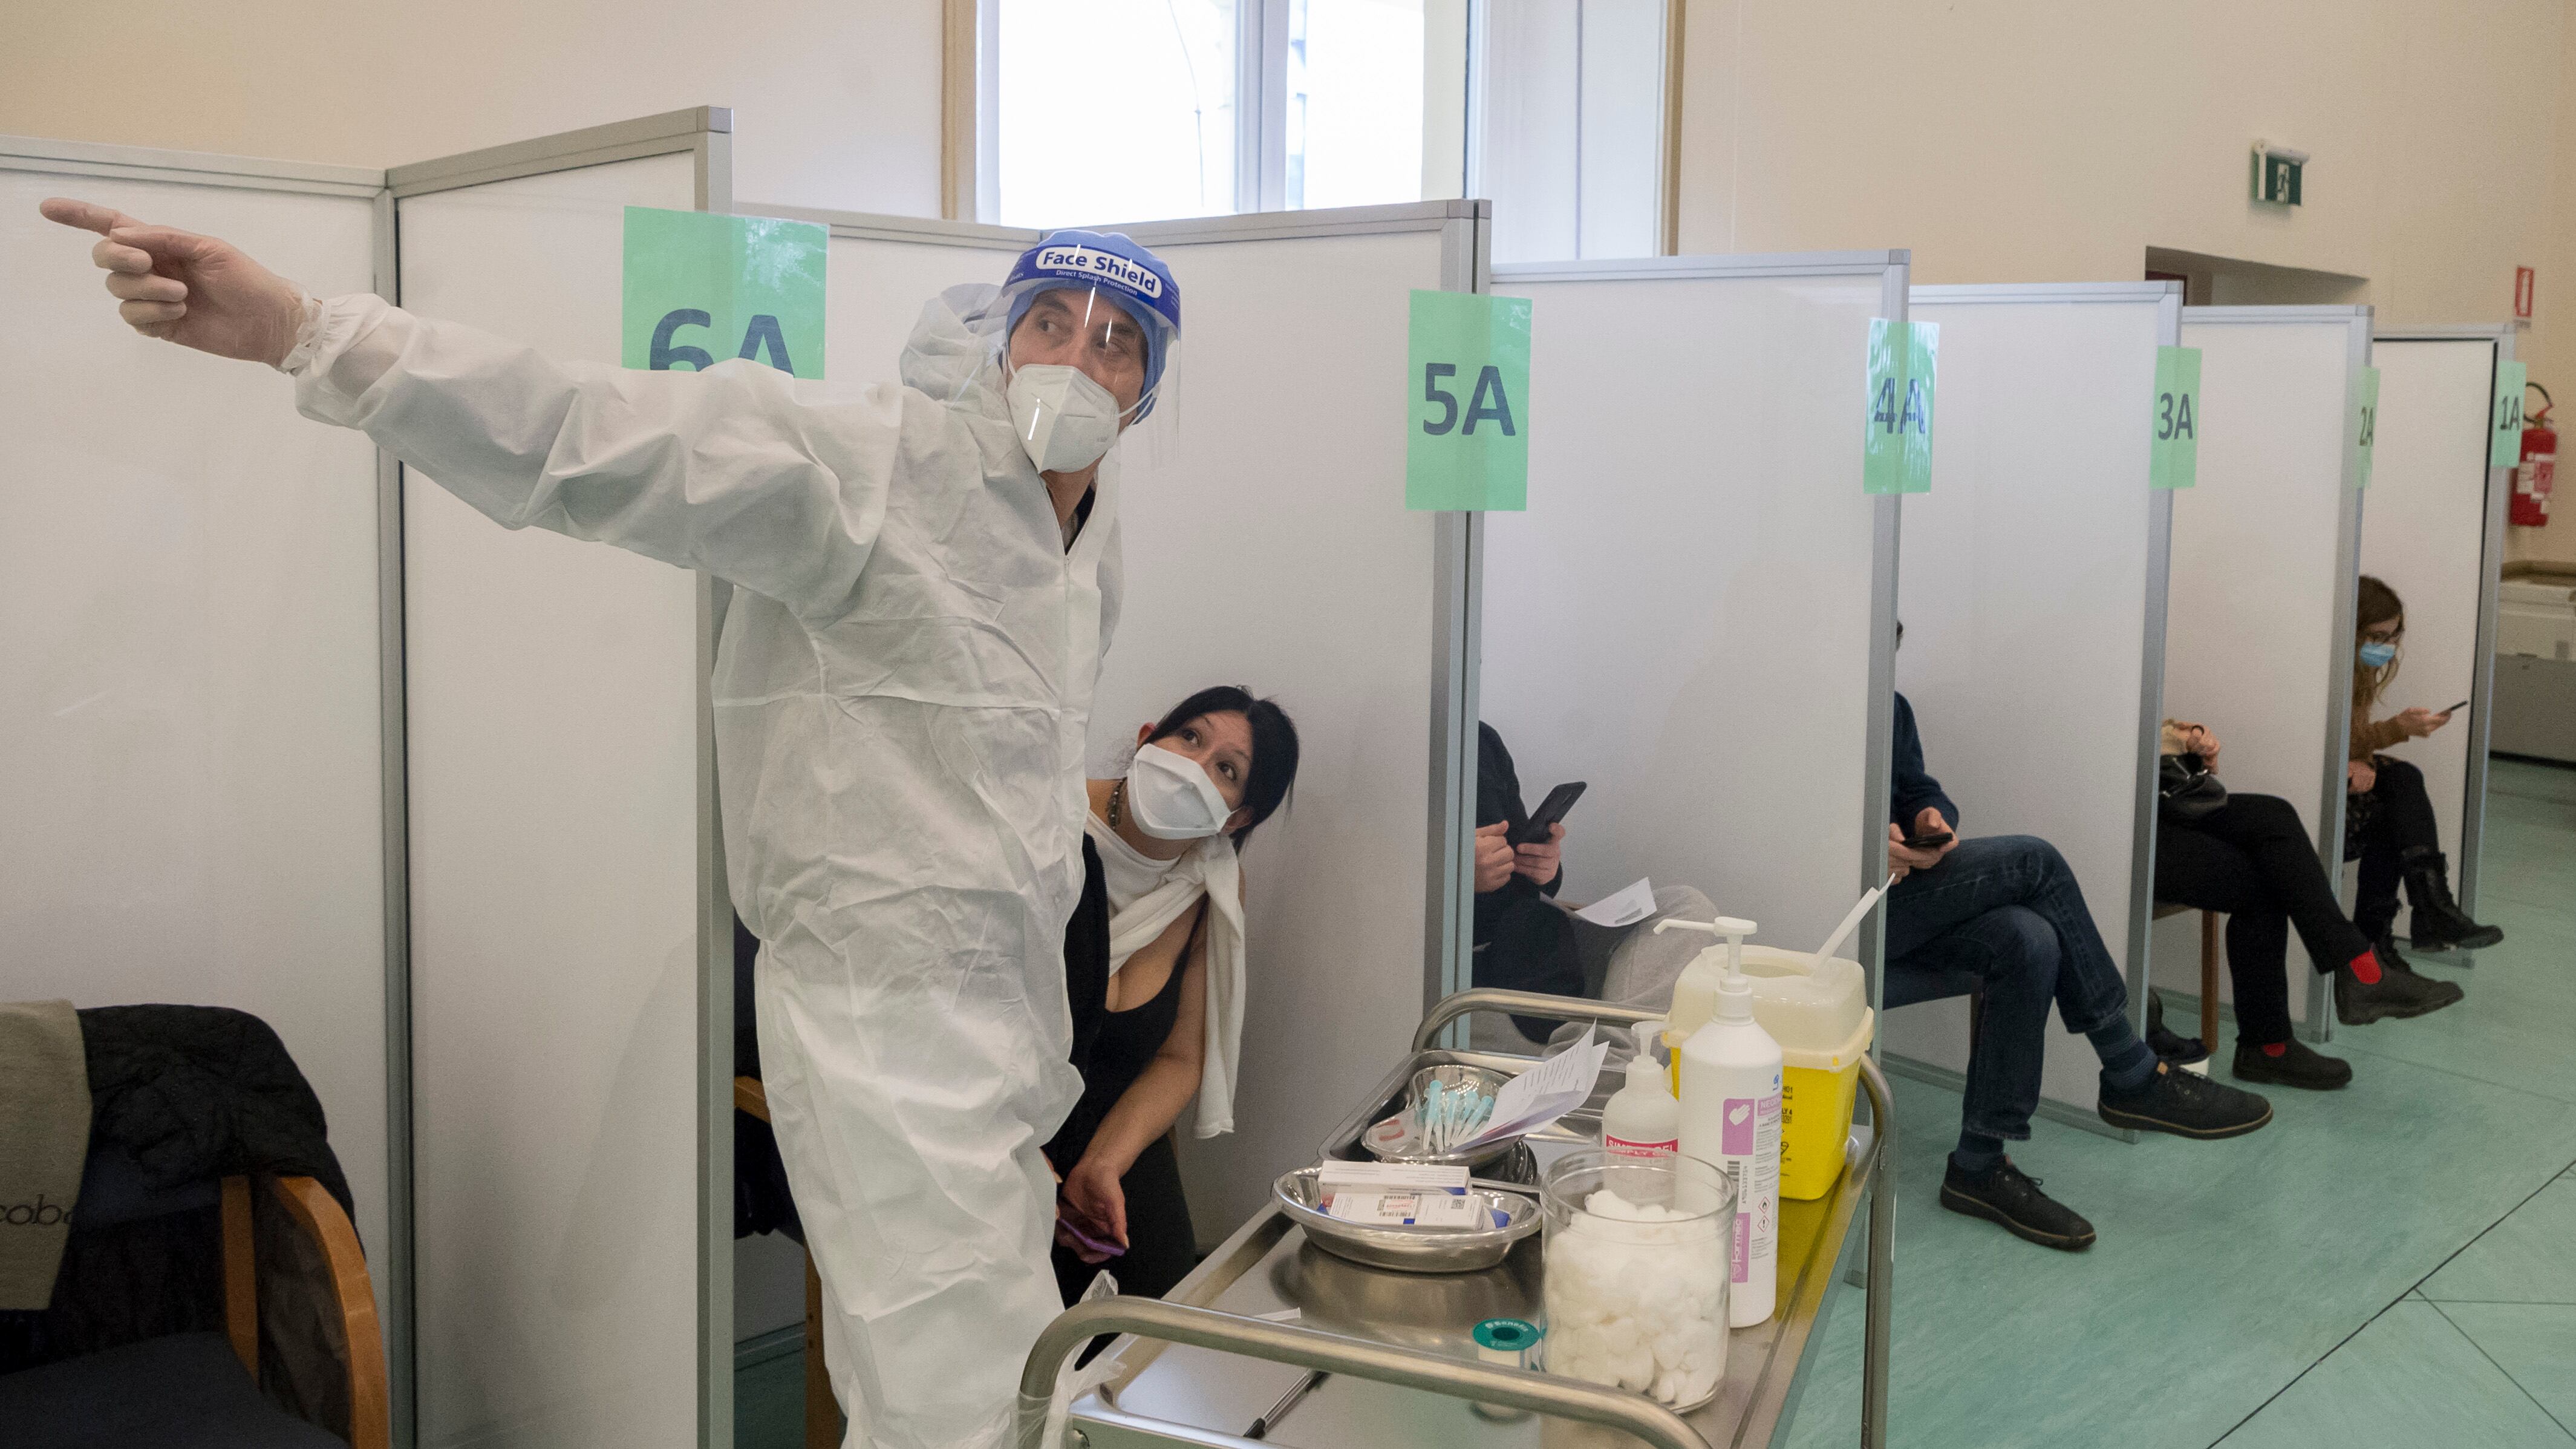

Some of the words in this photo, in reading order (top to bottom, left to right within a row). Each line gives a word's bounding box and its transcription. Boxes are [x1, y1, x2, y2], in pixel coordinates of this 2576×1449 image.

[1043, 251, 1087, 266] Face
[1094, 255, 1156, 293] Shield
[1078, 272, 1101, 282] Splash
[1103, 278, 1137, 296] Protection
[1423, 362, 1516, 436] 5A
[1874, 377, 1925, 434] 4A
[2158, 393, 2193, 440] 3A
[2500, 396, 2520, 431] 1A
[2359, 407, 2373, 446] 2A
